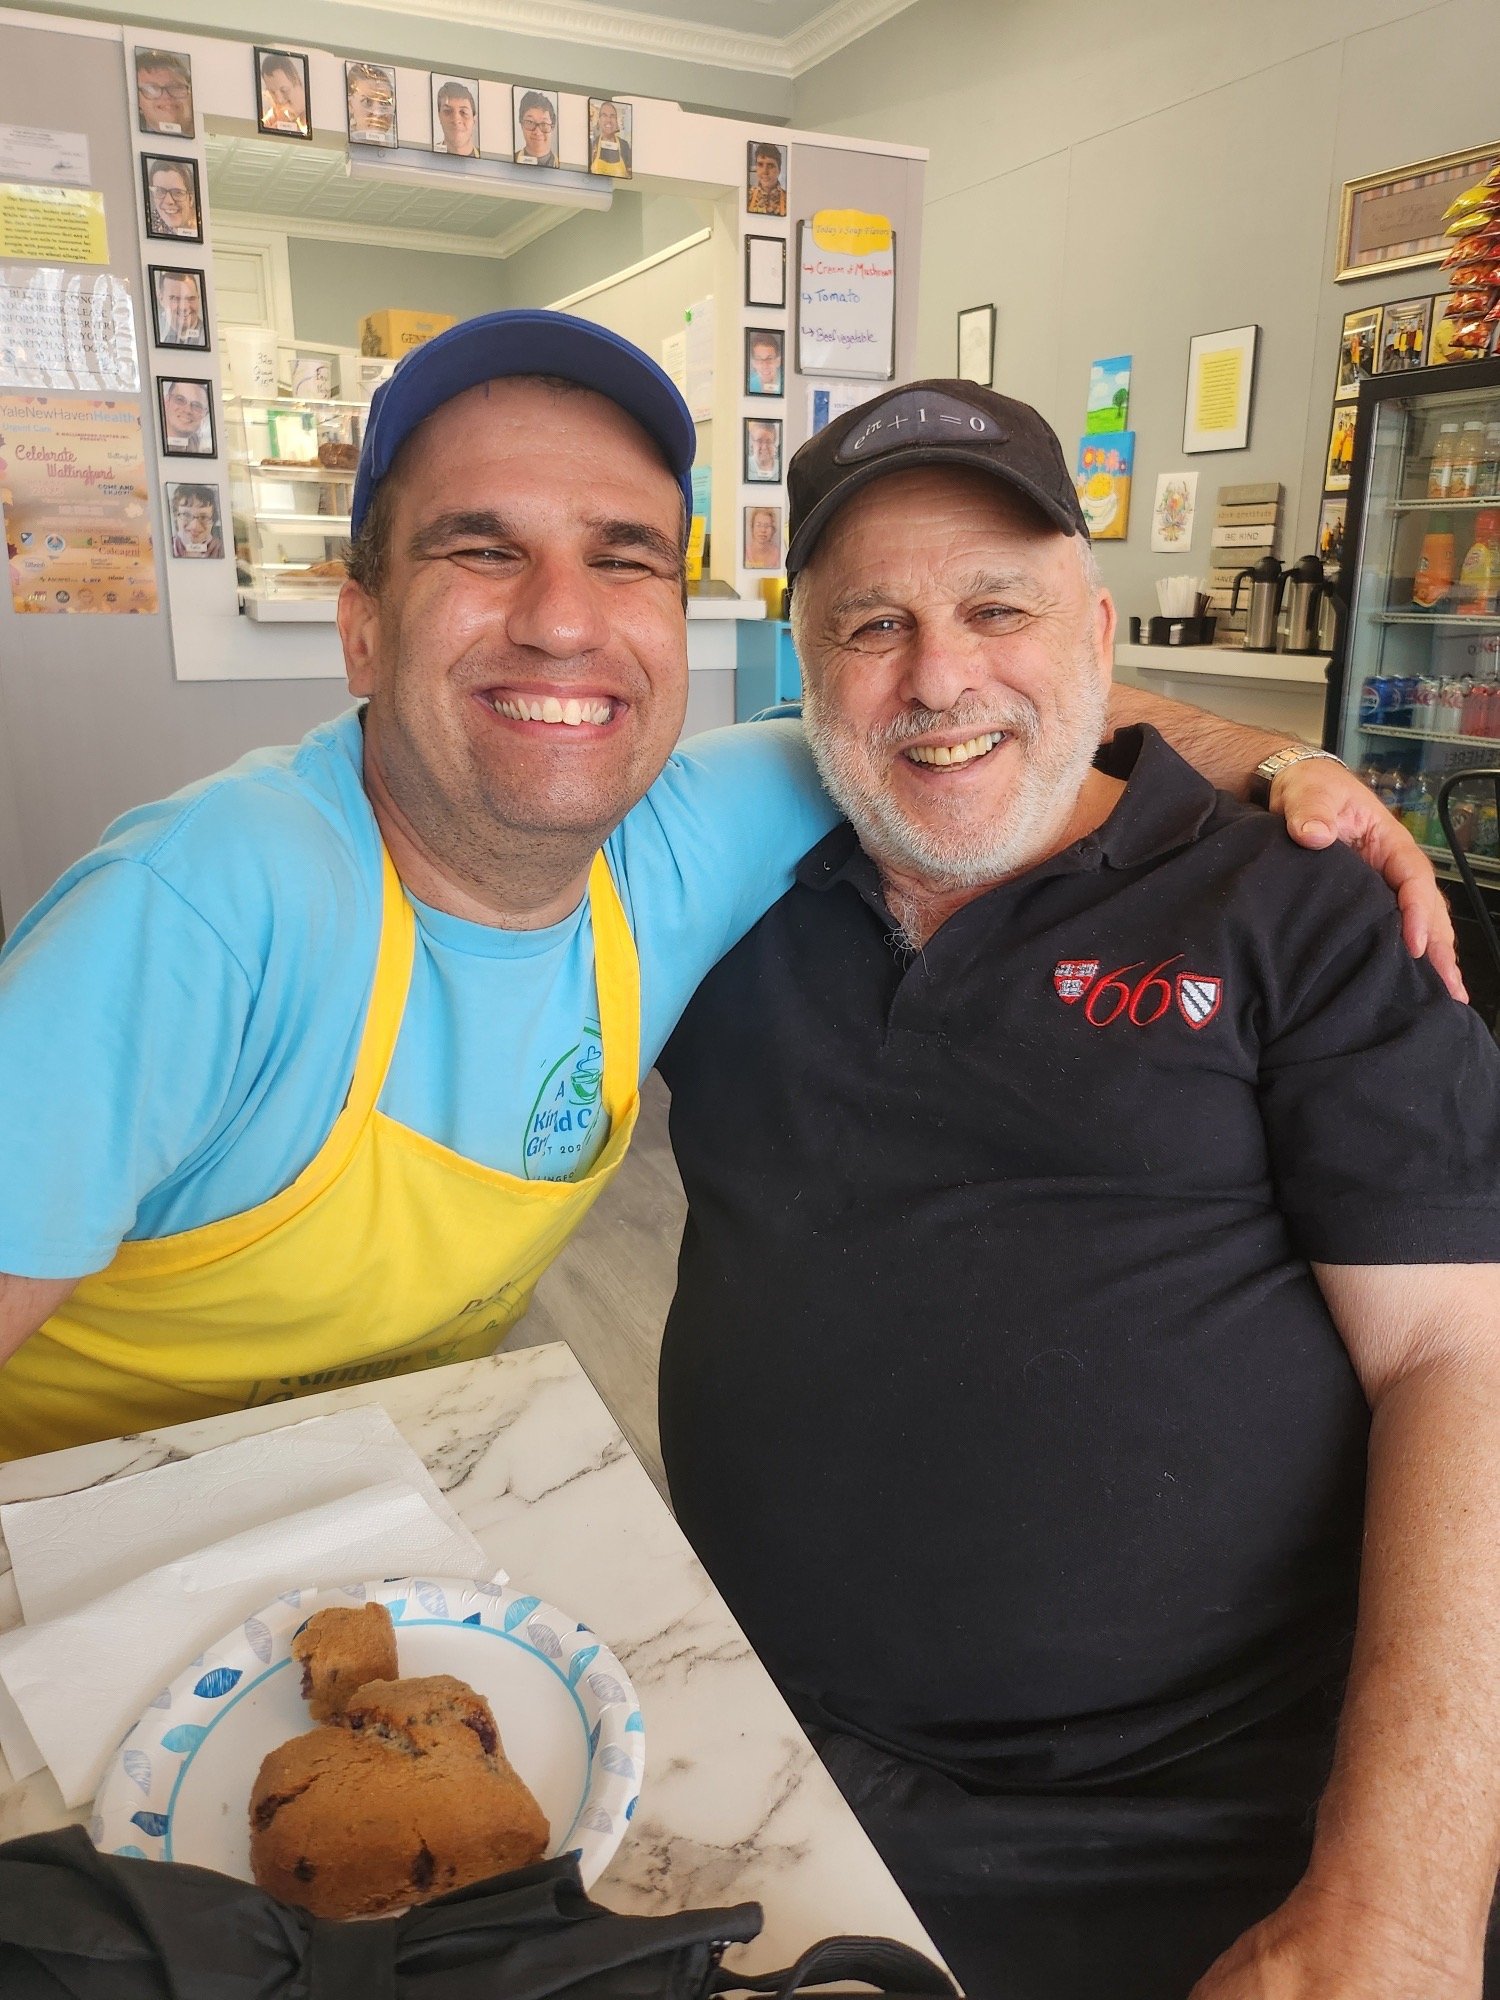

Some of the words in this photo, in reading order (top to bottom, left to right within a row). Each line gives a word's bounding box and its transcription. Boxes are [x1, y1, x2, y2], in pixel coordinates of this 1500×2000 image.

[816, 288, 861, 304] Tomato
[15, 444, 77, 462] Celebrate
[47, 463, 116, 486] Wallingford
[555, 1080, 565, 1101] A
[533, 1108, 572, 1133] Kind
